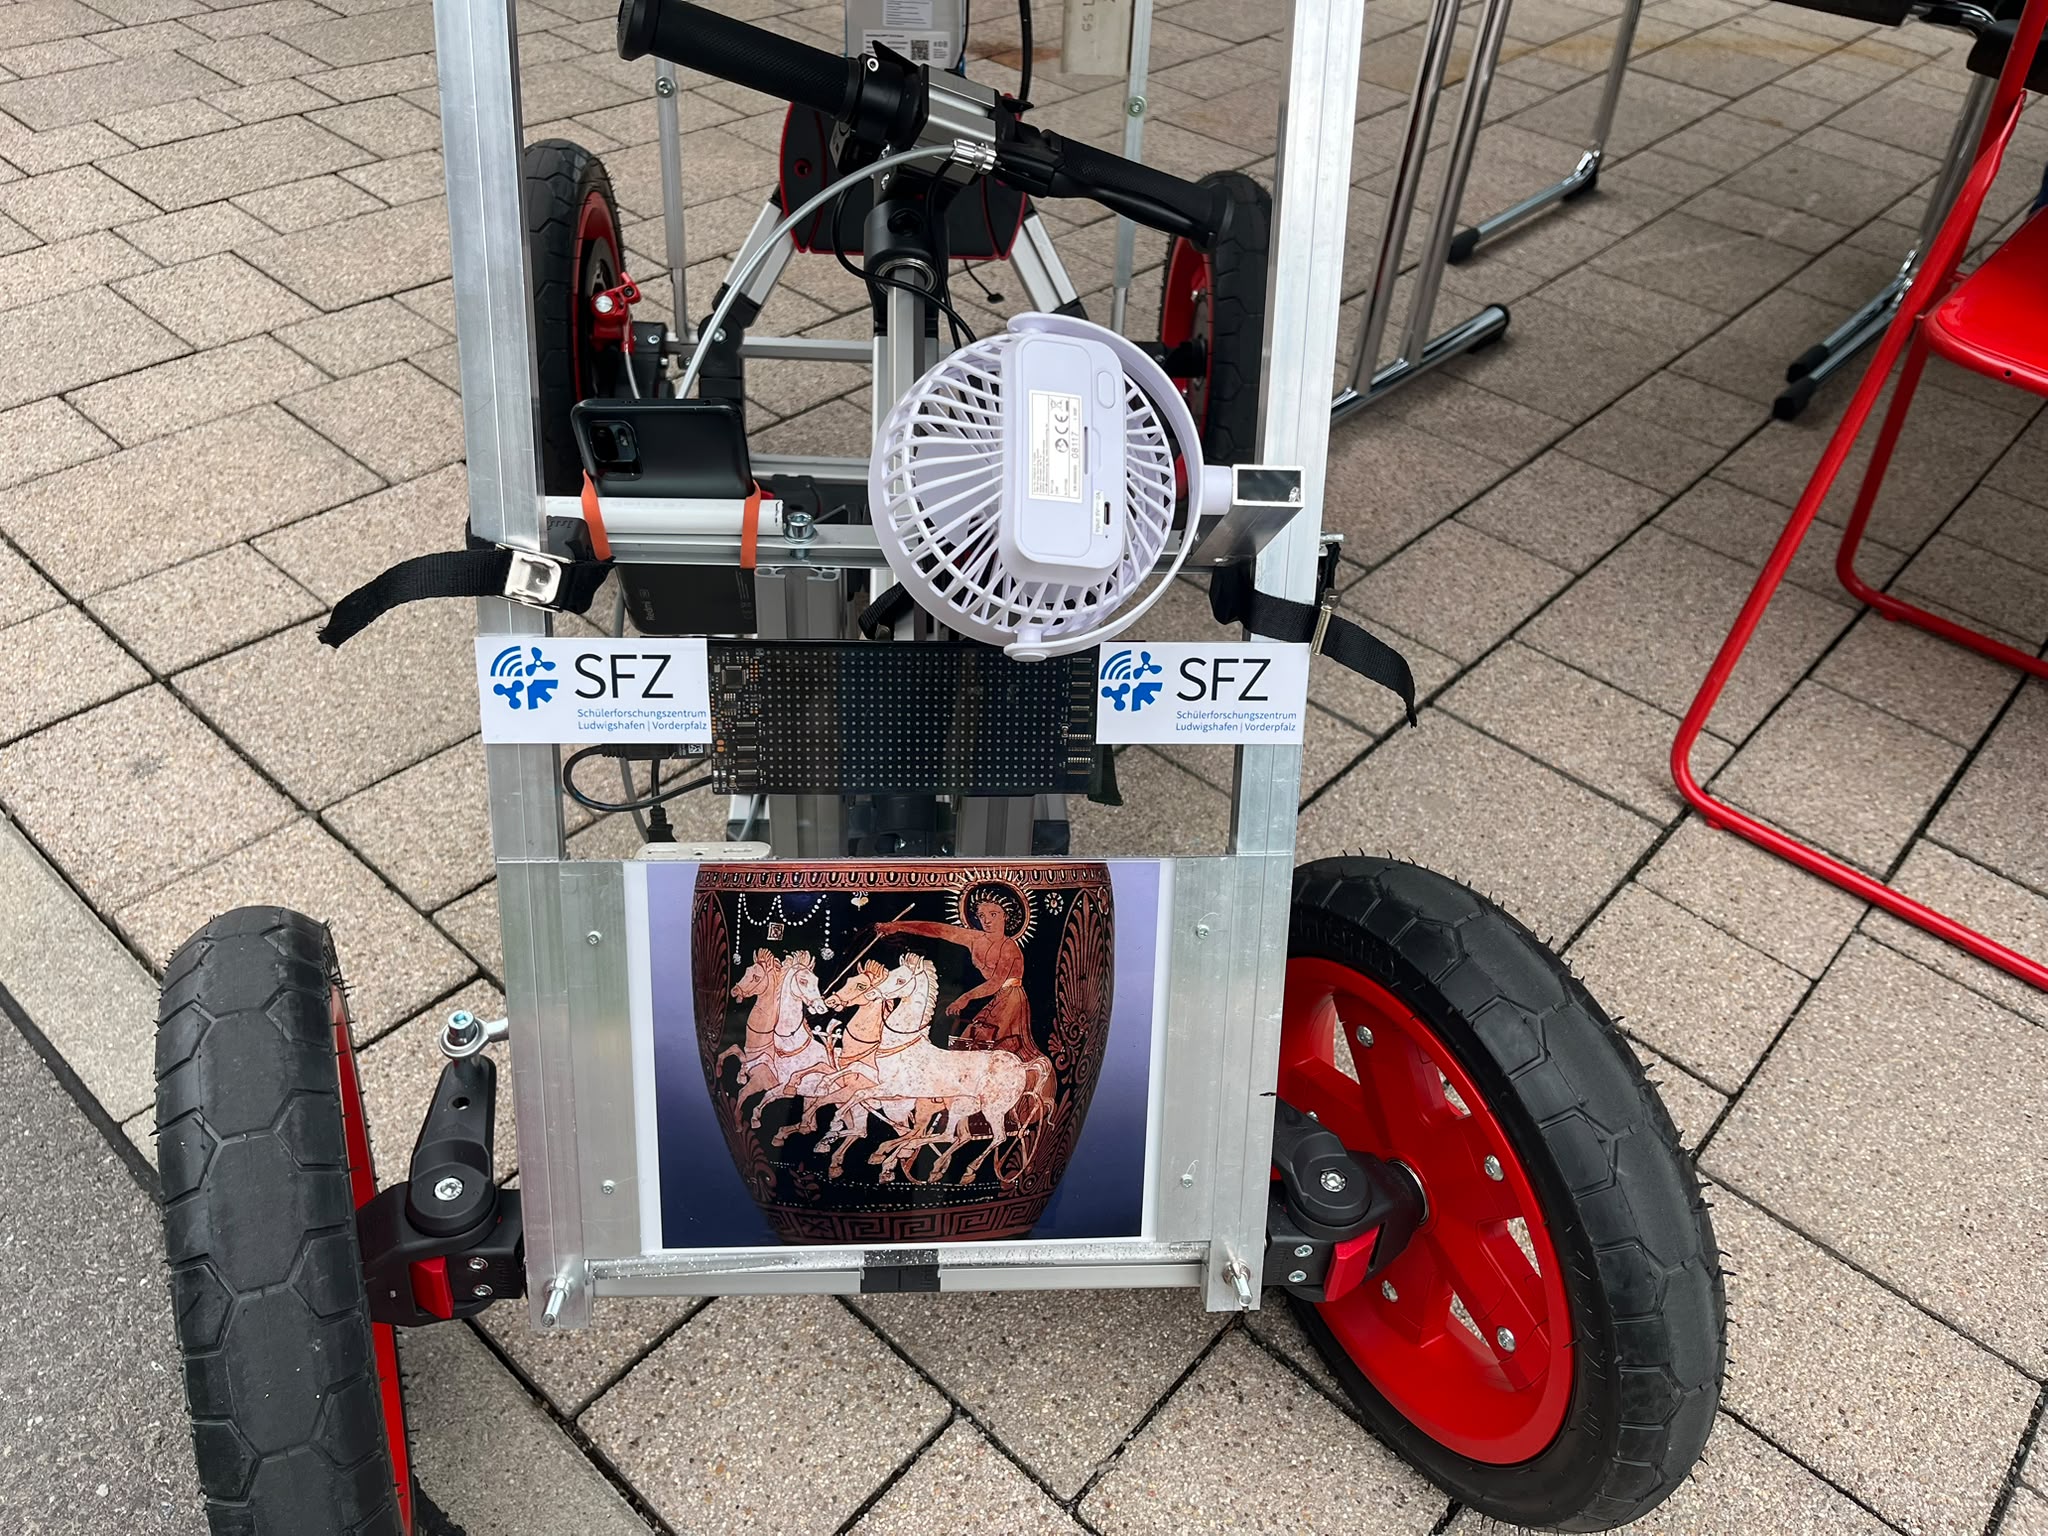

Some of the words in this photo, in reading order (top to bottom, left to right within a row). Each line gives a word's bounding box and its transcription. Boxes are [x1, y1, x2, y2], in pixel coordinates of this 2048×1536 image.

[574, 653, 674, 700] SFZ
[1176, 657, 1272, 702] SFZ
[577, 708, 707, 720] Schülerforschungszentrum
[1176, 710, 1297, 721] Schülerforschungszentrum
[577, 720, 645, 732] Ludwigshafen
[652, 720, 708, 732] Vorderpfalz
[1175, 721, 1238, 733] Ludwigshafen
[1244, 721, 1296, 733] Vorderpfalz
